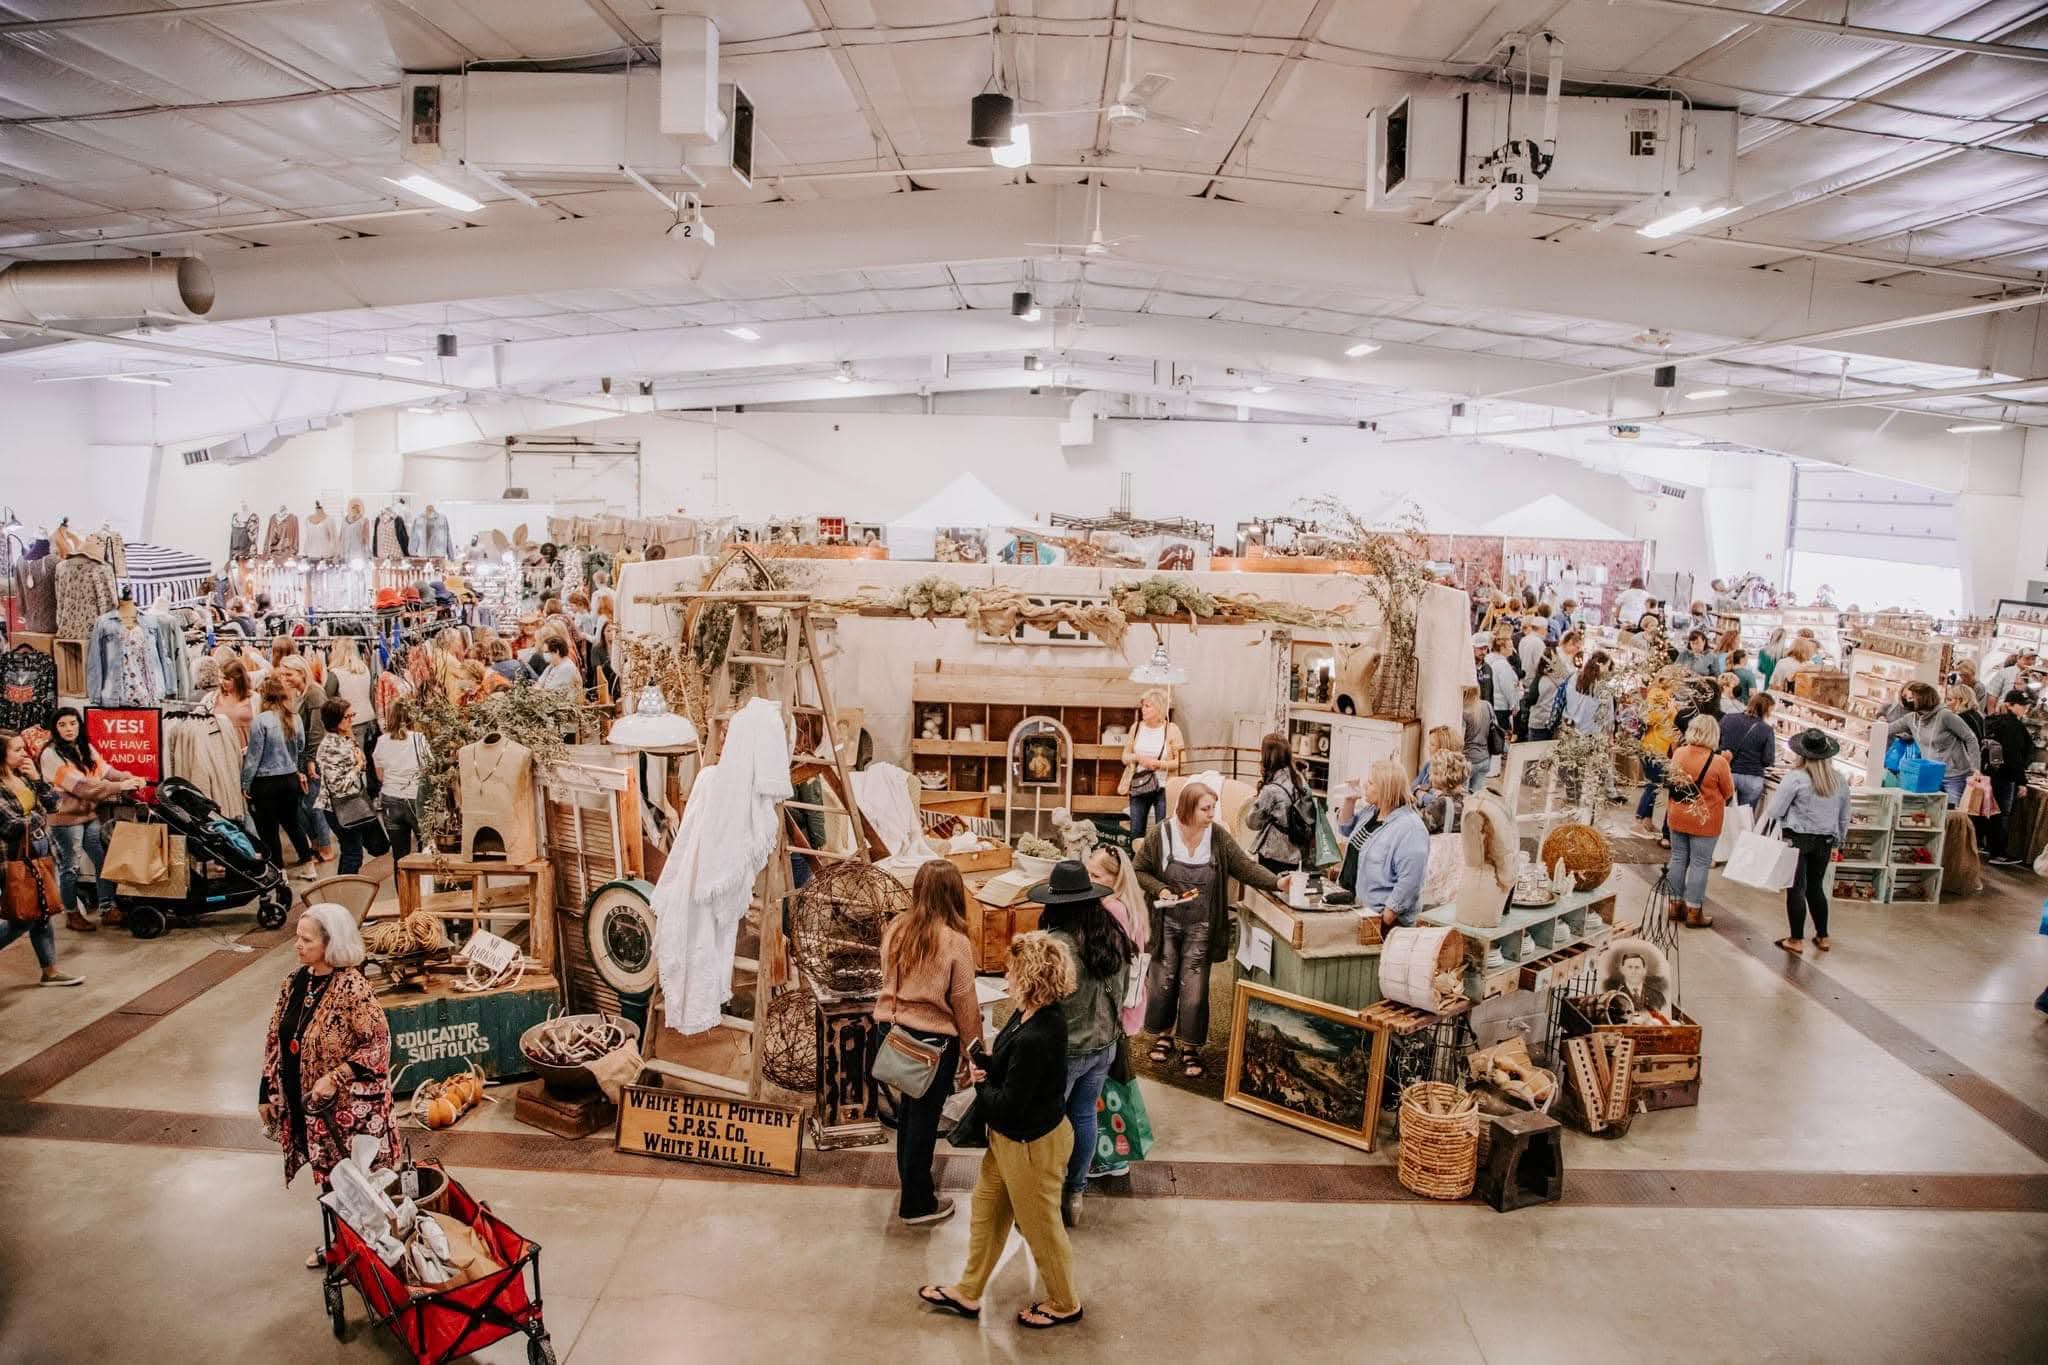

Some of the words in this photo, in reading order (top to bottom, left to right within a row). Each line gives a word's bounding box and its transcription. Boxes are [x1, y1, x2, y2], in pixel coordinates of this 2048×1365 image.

[1514, 186, 1524, 202] 3
[684, 225, 692, 238] 2
[102, 719, 145, 734] YES!
[98, 740, 117, 750] WE
[120, 740, 151, 750] HAVE
[110, 753, 135, 763] AND
[137, 753, 156, 764] UP!
[608, 906, 644, 923] TOLEDO
[396, 1022, 479, 1048] EDUCATOR
[408, 1036, 490, 1063] SUFFOLKS
[630, 1089, 679, 1112] WHITE
[682, 1097, 723, 1118] HALL
[728, 1103, 795, 1128] POTTERY
[668, 1116, 721, 1139] S.P.&S.
[644, 1132, 694, 1157] WHITE
[698, 1140, 738, 1162] HALL
[743, 1146, 771, 1167] ILL.
